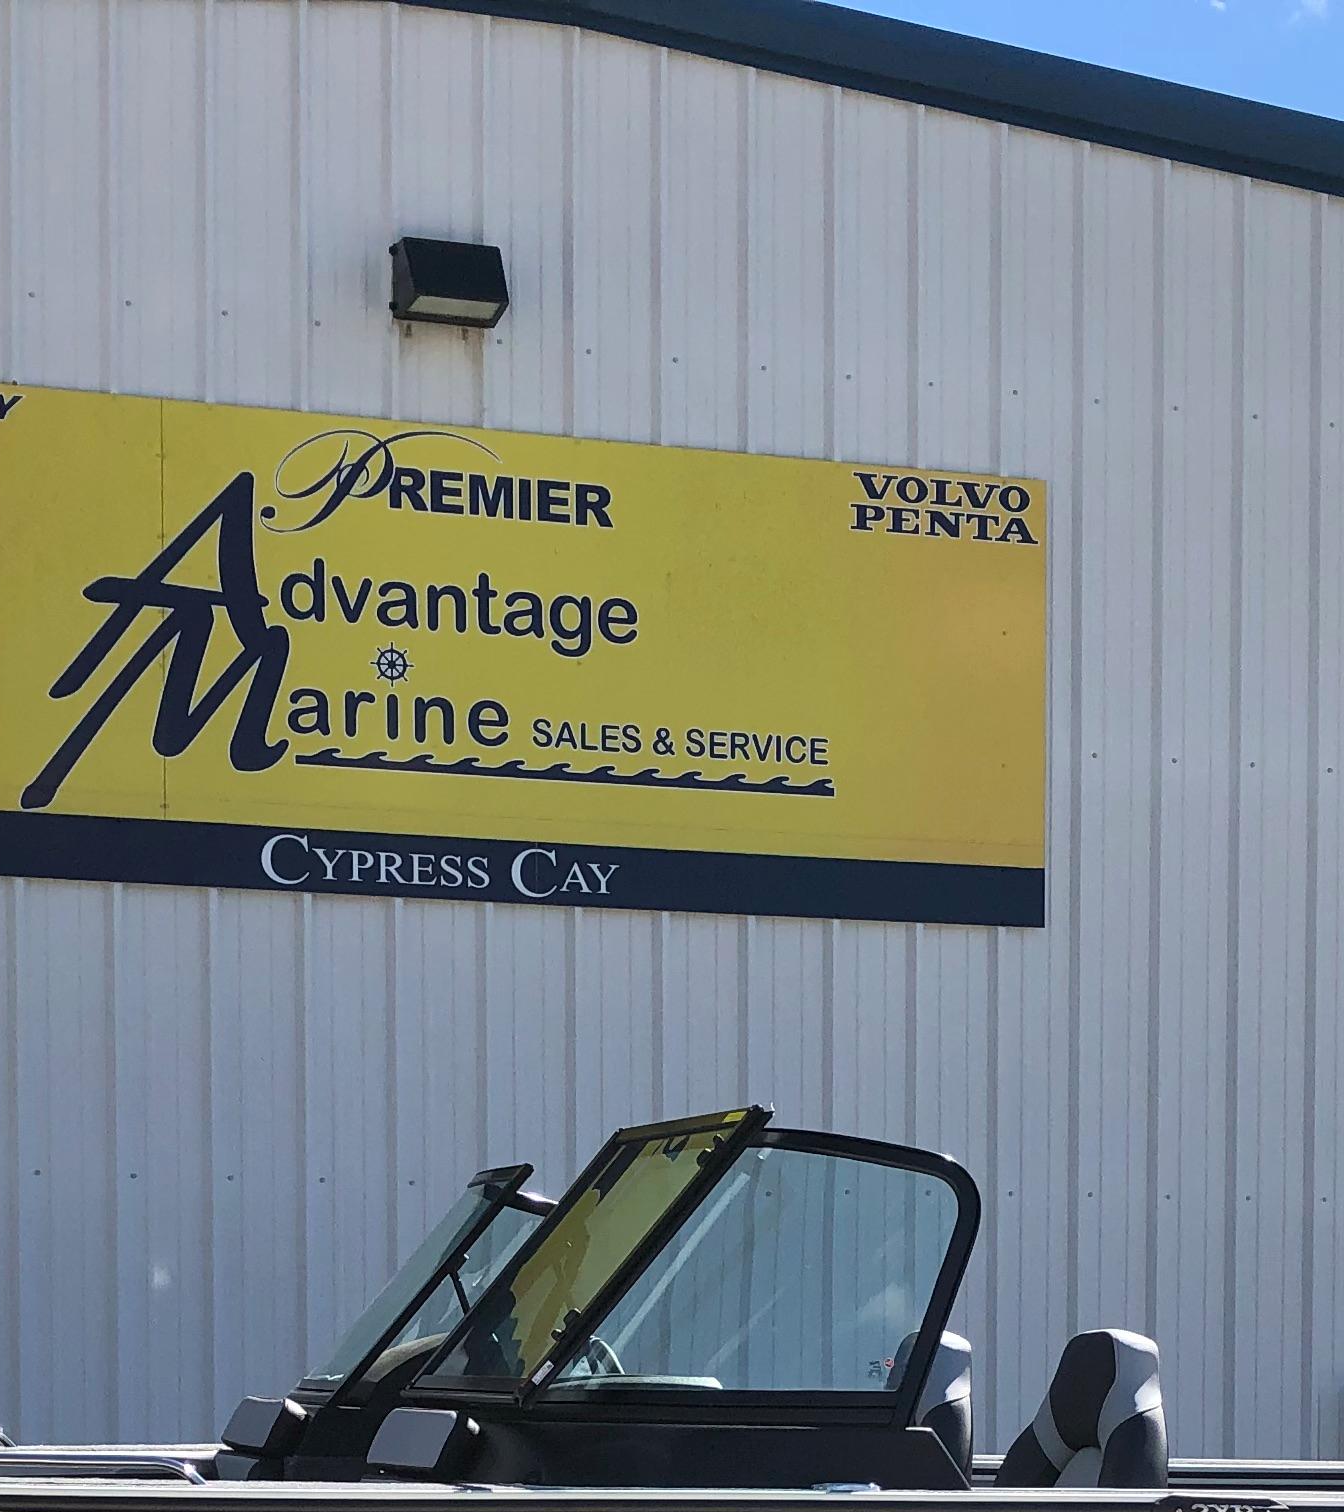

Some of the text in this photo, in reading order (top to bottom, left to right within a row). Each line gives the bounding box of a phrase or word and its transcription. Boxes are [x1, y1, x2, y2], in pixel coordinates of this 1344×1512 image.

[260, 430, 613, 532] PREMIER
[853, 472, 1031, 513] VOLVO
[849, 503, 1038, 545] PENTA
[49, 471, 638, 699] Advantage
[20, 602, 828, 809] Marine SALES & SERVICE
[261, 834, 619, 899] CYPRESS CAY
